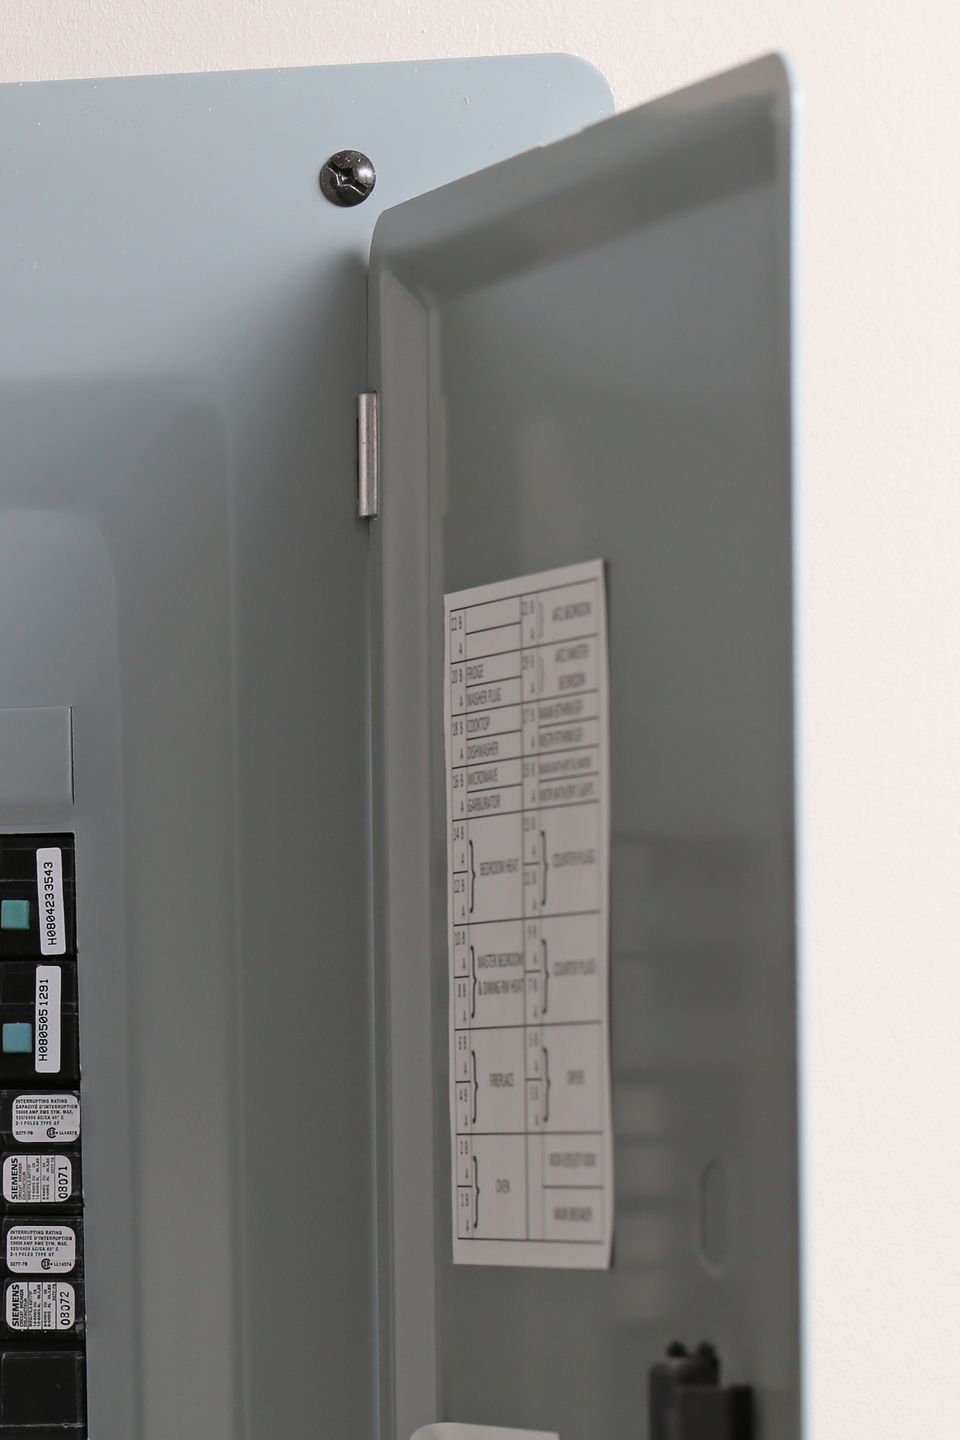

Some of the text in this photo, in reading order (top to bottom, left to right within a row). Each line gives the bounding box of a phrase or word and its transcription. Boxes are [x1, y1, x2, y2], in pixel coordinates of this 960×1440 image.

[467, 716, 490, 733] COOKTOP
[39, 978, 49, 1062] H0805051291
[11, 1284, 20, 1327] SIEMENS
